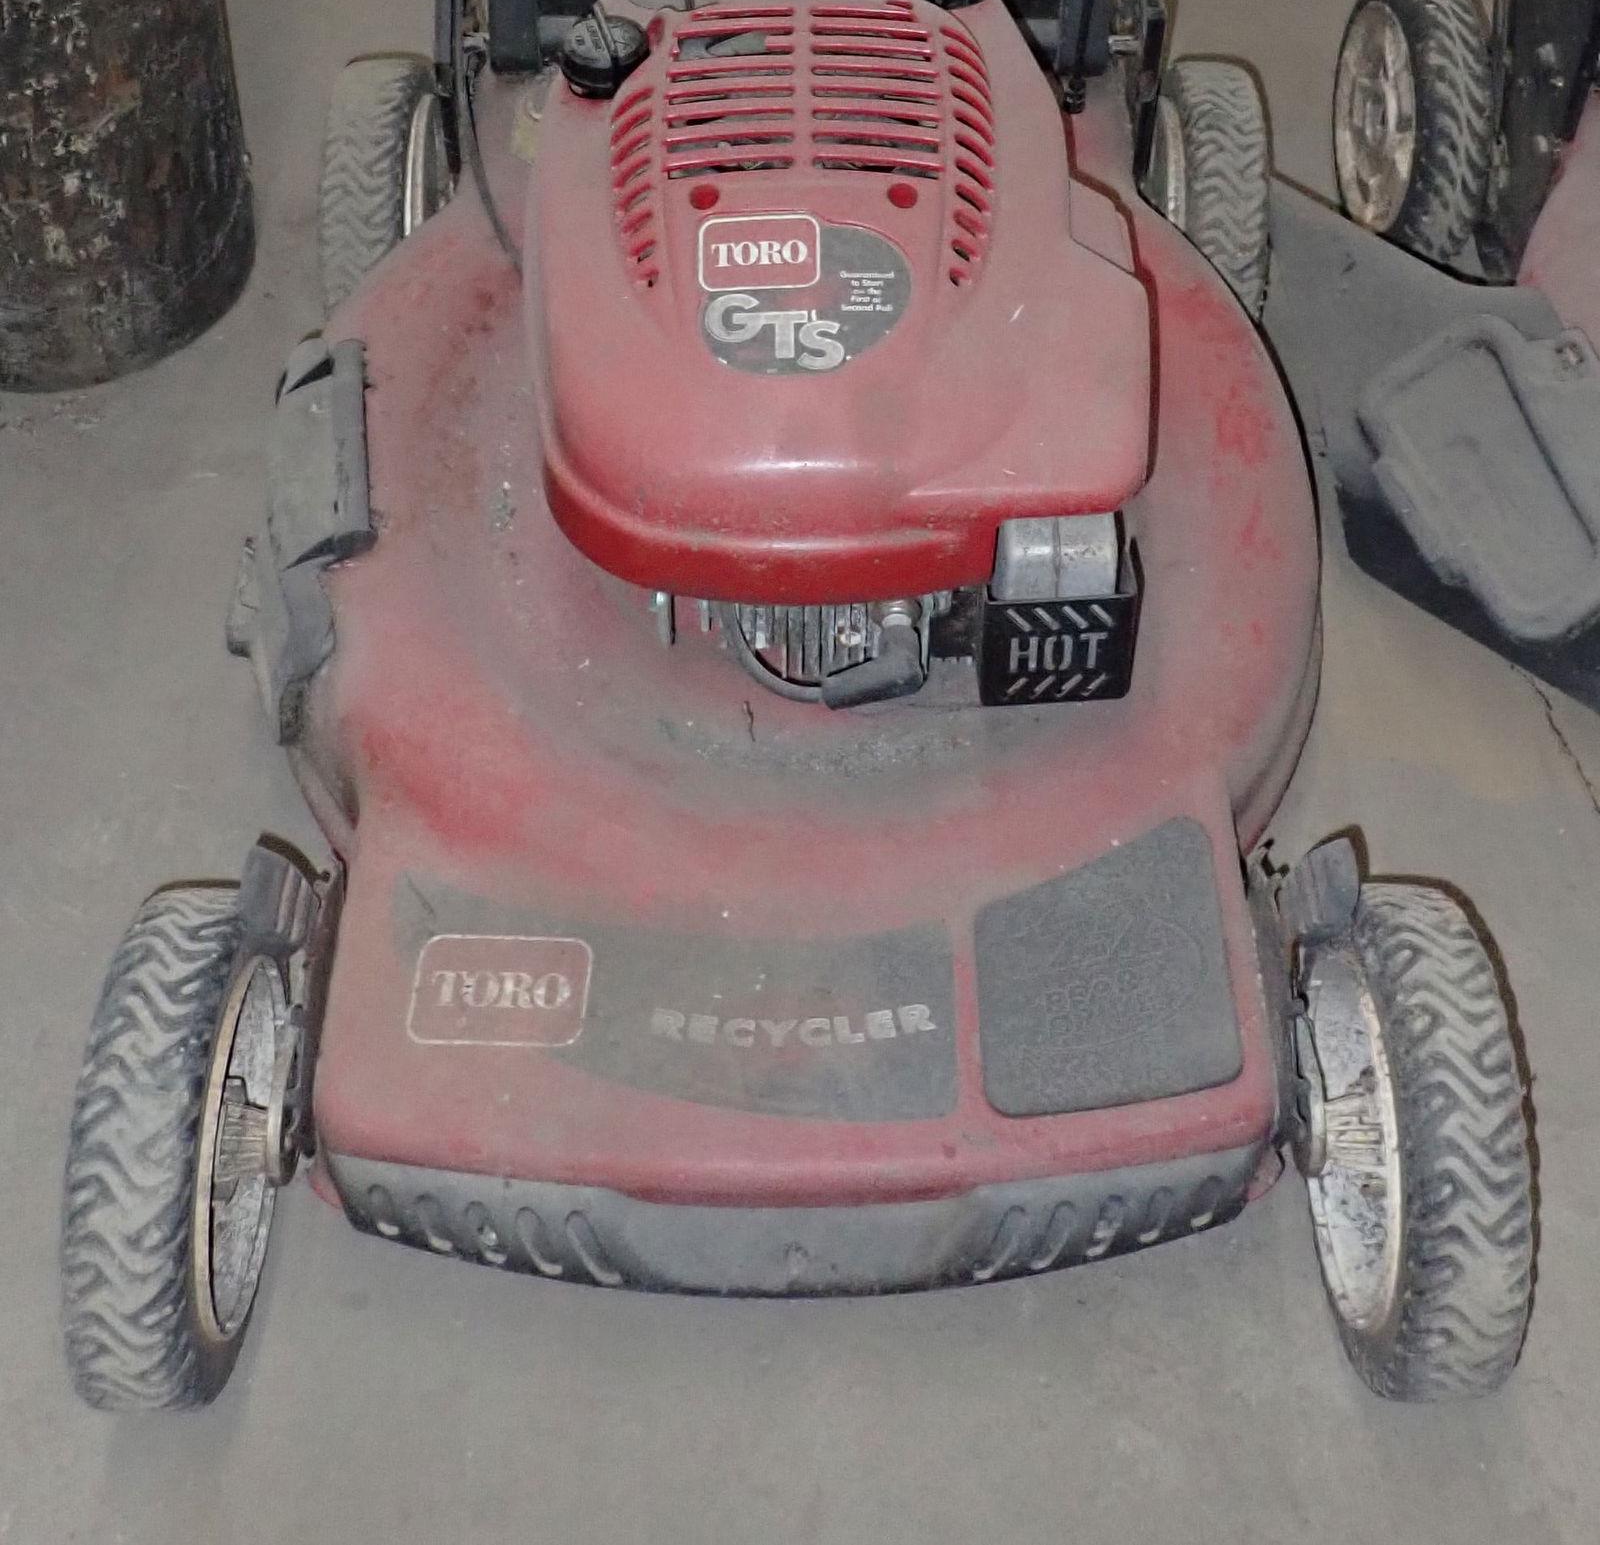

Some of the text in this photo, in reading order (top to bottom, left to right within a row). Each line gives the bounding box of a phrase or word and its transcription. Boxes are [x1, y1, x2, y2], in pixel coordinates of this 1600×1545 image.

[711, 239, 808, 268] TORO
[861, 279, 884, 287] Start
[840, 303, 874, 312] Second
[704, 293, 845, 370] GTS
[1009, 632, 1108, 673] HOT
[431, 970, 571, 1009] TORO
[651, 1003, 937, 1048] RECYCLER
